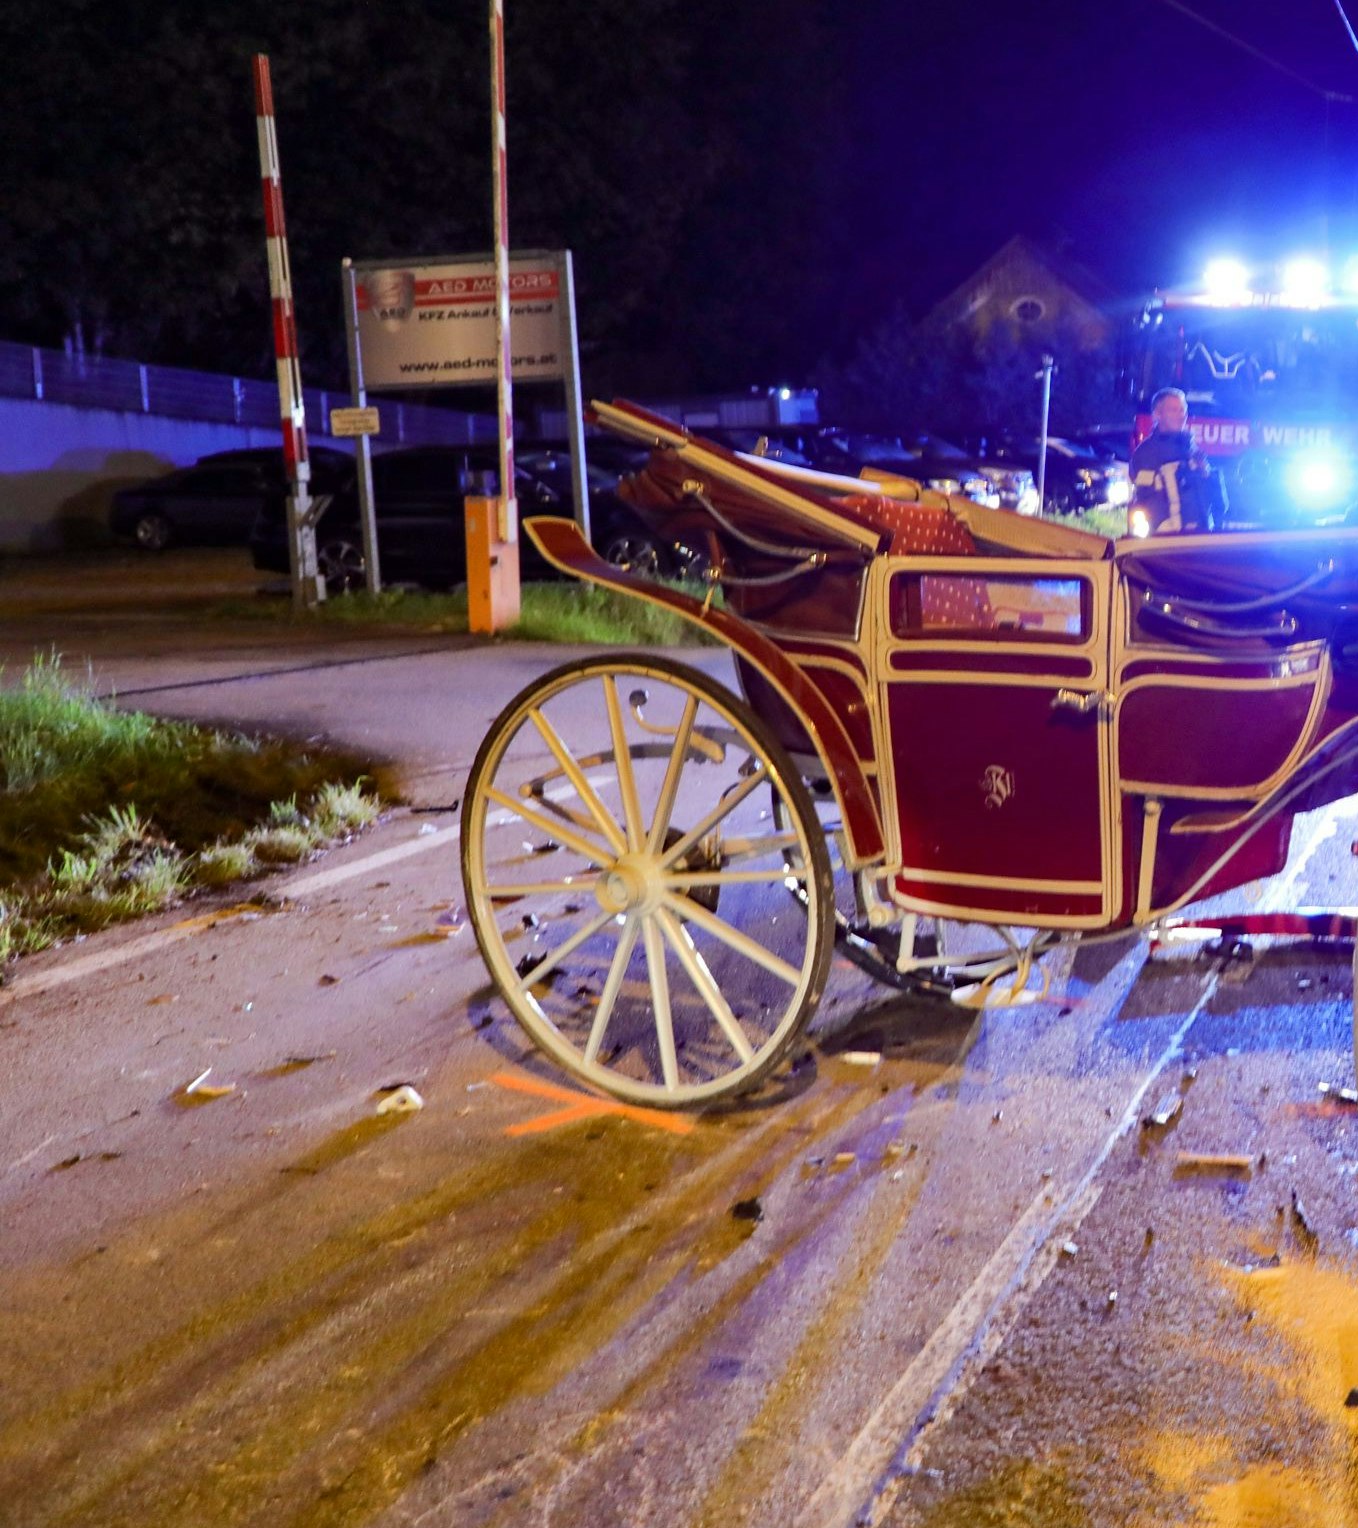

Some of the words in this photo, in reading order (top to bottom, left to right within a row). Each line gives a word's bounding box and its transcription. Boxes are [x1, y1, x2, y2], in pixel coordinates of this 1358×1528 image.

[428, 280, 467, 295] AED
[472, 273, 552, 292] MOORS
[418, 310, 445, 321] KFZ
[447, 307, 490, 319] Ankauf
[400, 353, 557, 373] www.aed-moors.at
[1185, 423, 1250, 446] EUER
[1263, 426, 1331, 447] WEHR
